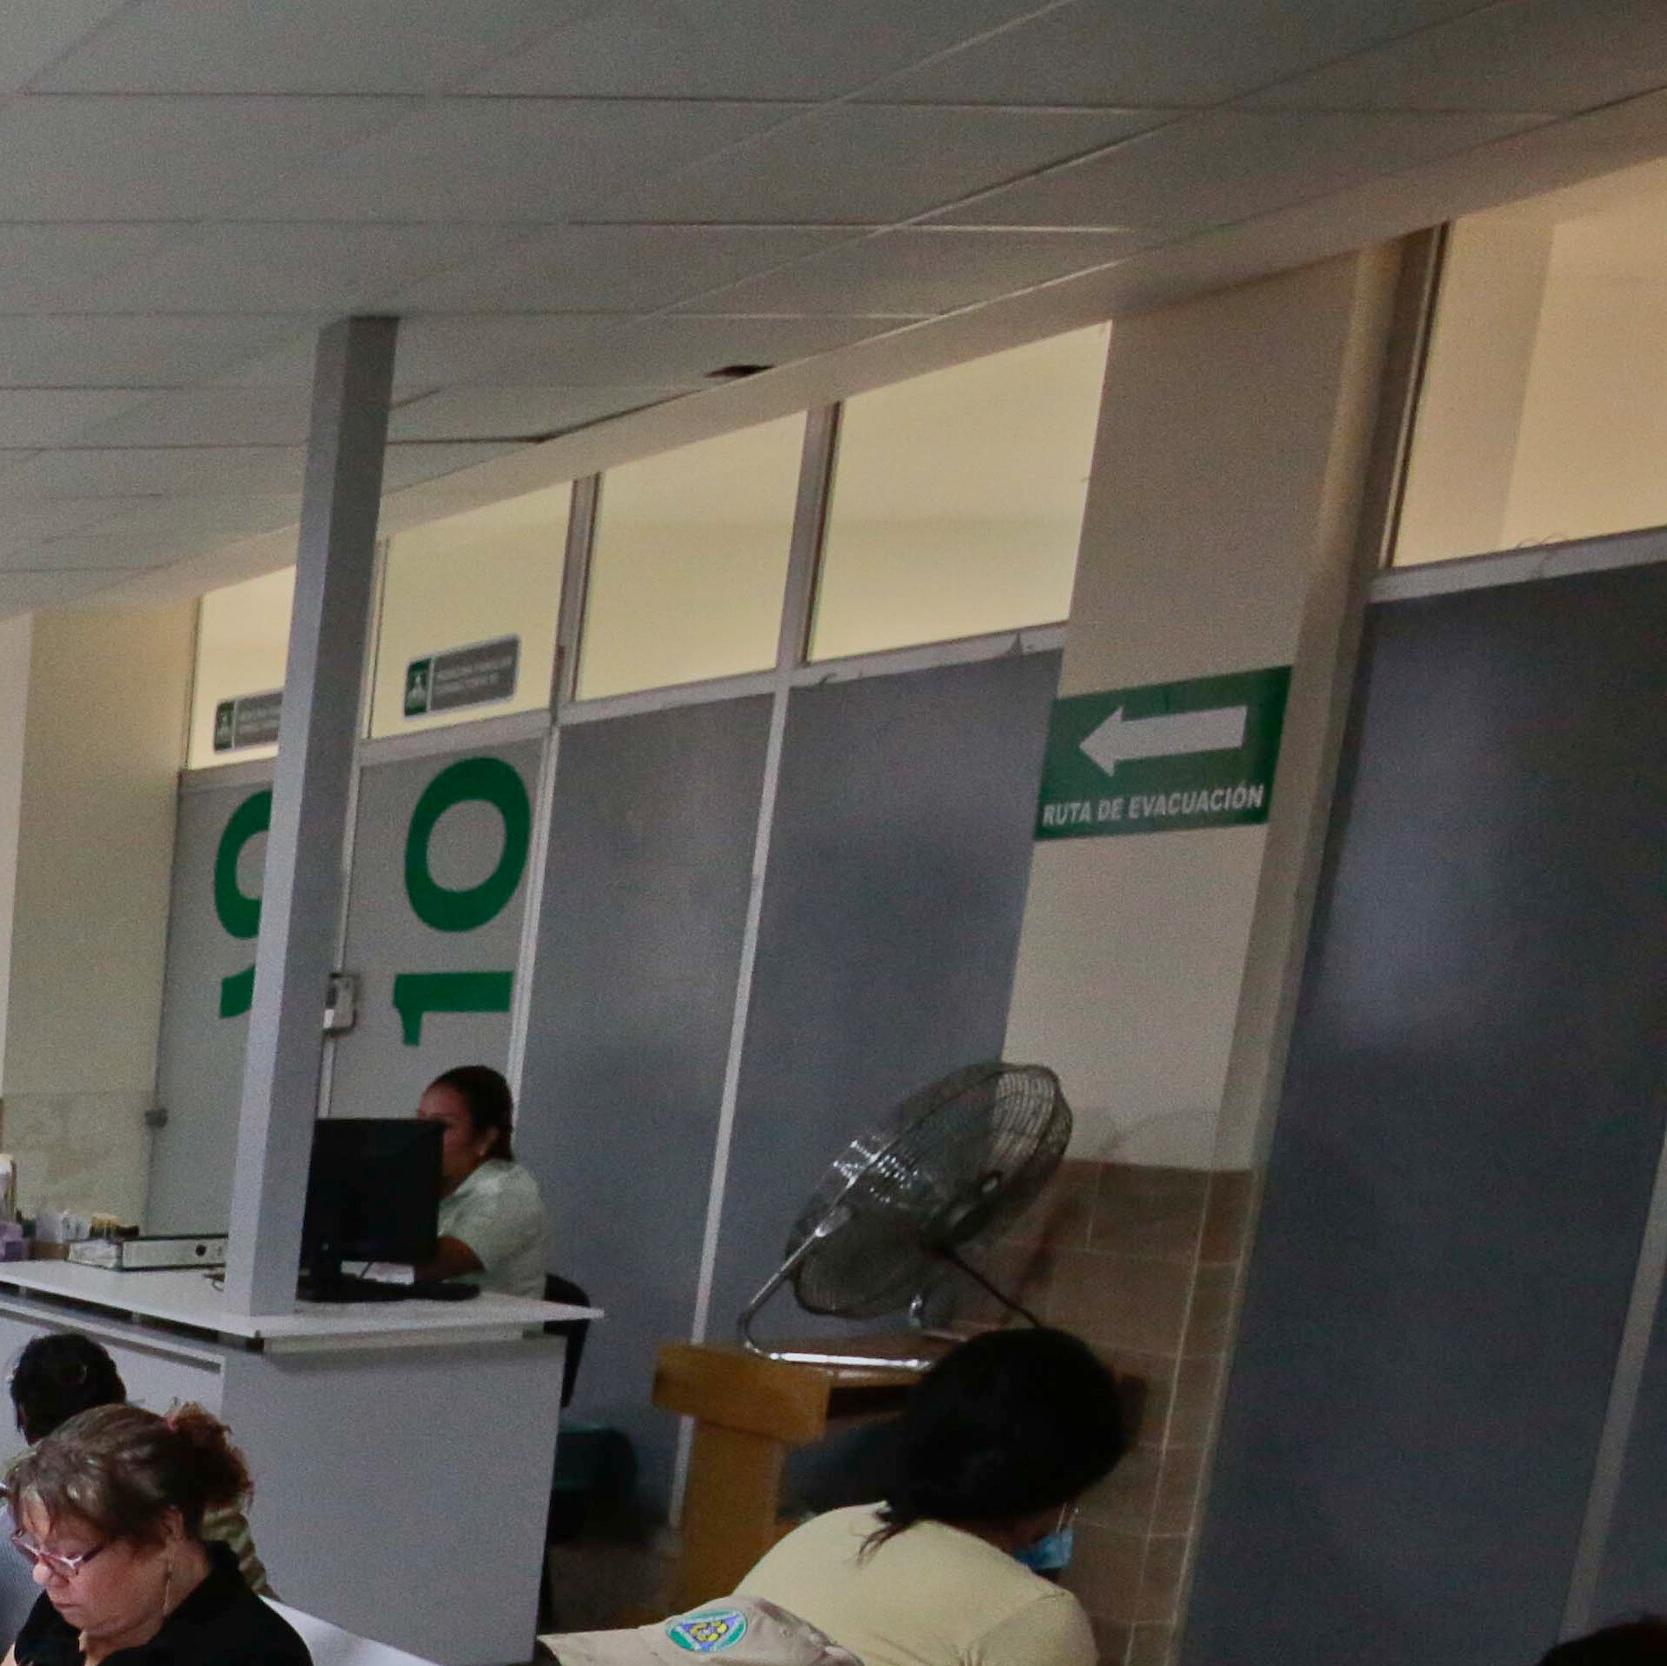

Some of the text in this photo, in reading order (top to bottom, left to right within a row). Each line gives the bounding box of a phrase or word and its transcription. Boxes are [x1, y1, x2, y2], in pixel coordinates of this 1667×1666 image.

[1042, 782, 1265, 826] RUTA DE EVACUACIÓN
[392, 756, 532, 1047] 10
